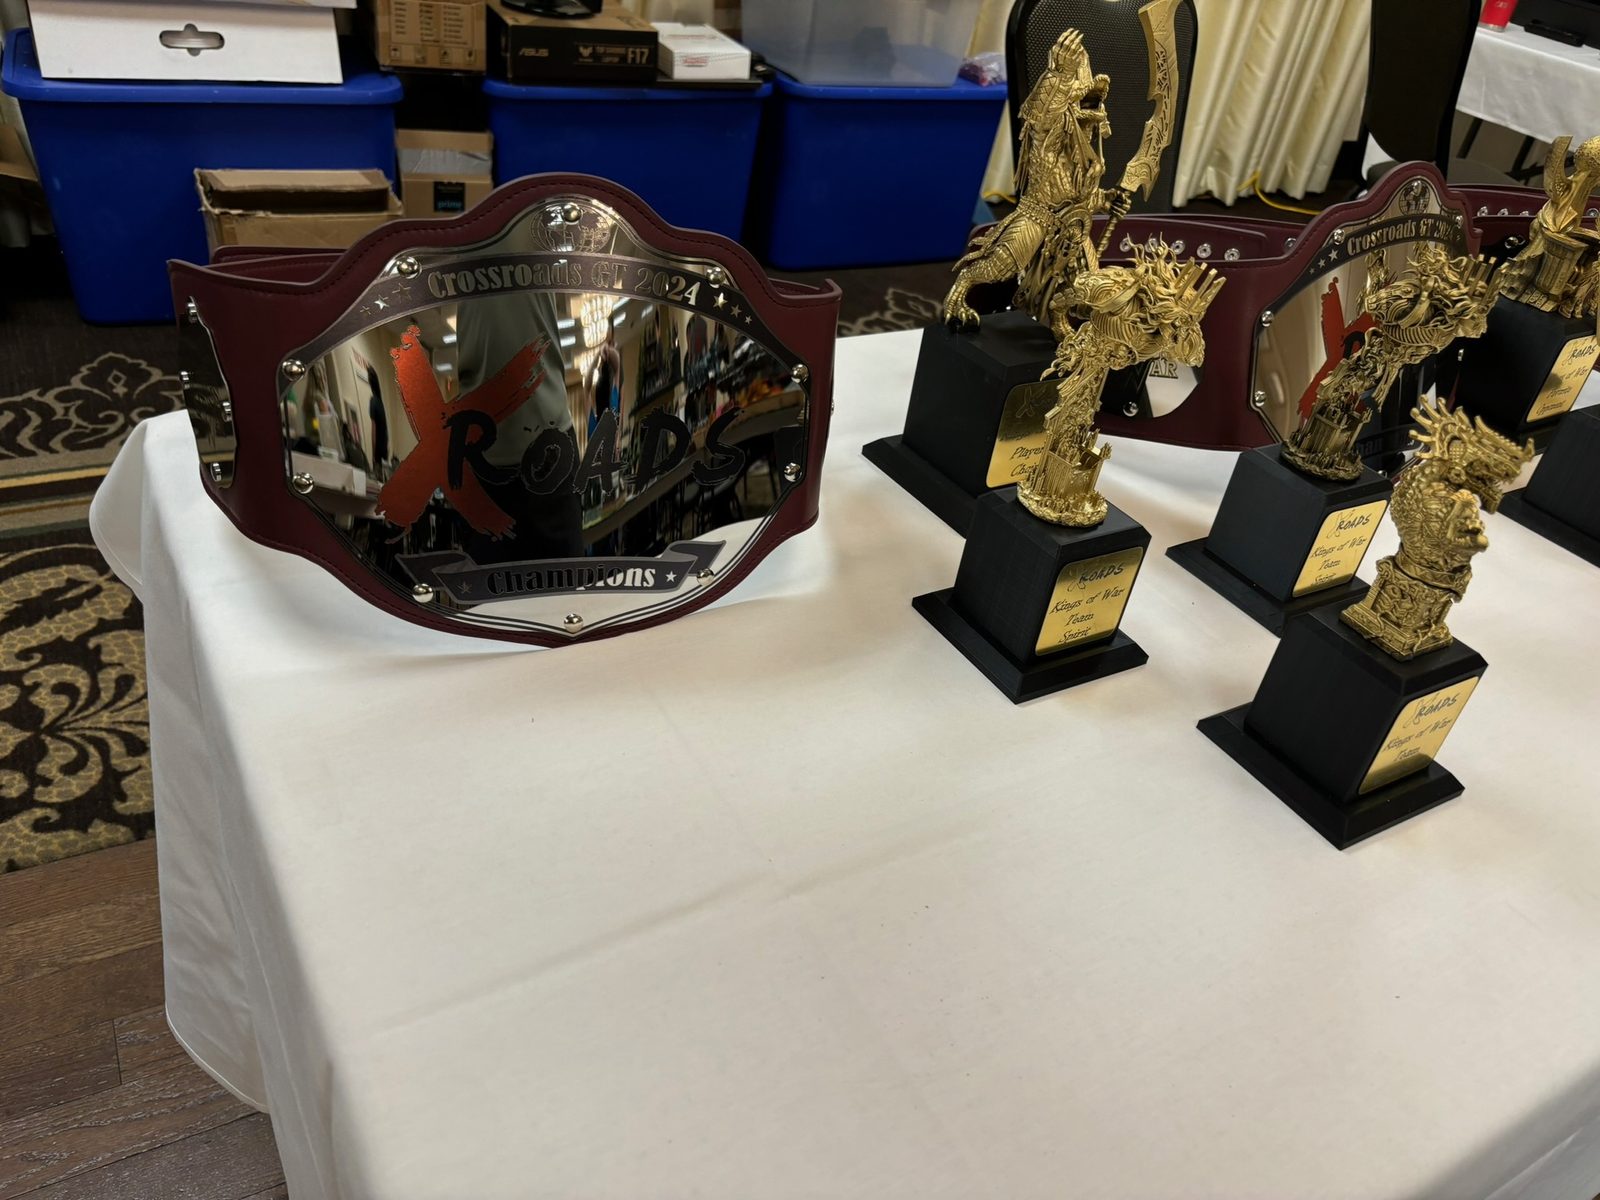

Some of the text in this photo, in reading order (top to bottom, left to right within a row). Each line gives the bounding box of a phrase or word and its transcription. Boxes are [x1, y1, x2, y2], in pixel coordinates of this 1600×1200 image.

[627, 47, 650, 65] F17
[1346, 219, 1417, 256] Crossroads
[427, 258, 701, 306] Crossroads GT 2024
[486, 563, 656, 596] Champions
[1049, 585, 1125, 614] Kings of War
[1065, 613, 1094, 626] Team
